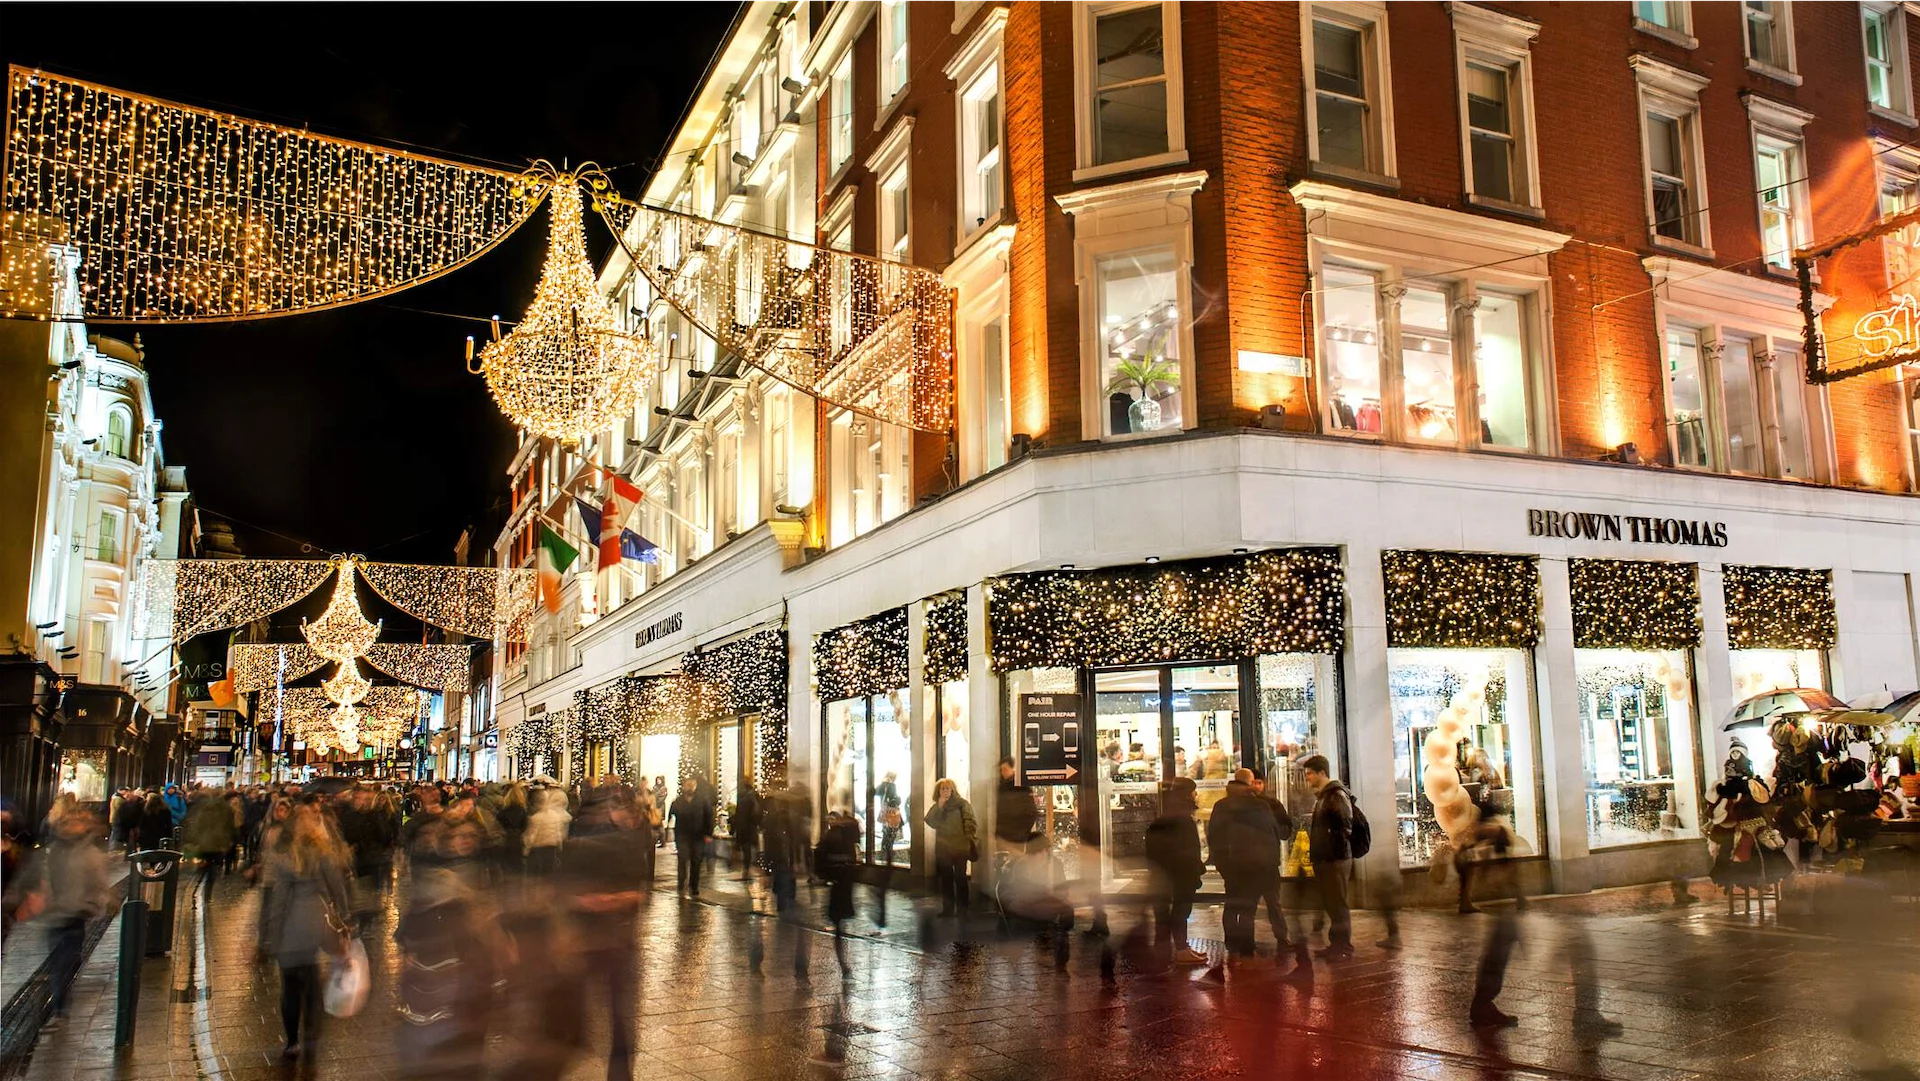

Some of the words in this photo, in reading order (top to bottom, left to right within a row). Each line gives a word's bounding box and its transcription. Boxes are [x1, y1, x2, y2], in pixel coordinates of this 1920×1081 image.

[1528, 509, 1621, 541] BROWN
[1625, 516, 1728, 547] THOMAS
[184, 662, 223, 679] M&S
[50, 679, 74, 690] M&S
[78, 708, 88, 717] 16
